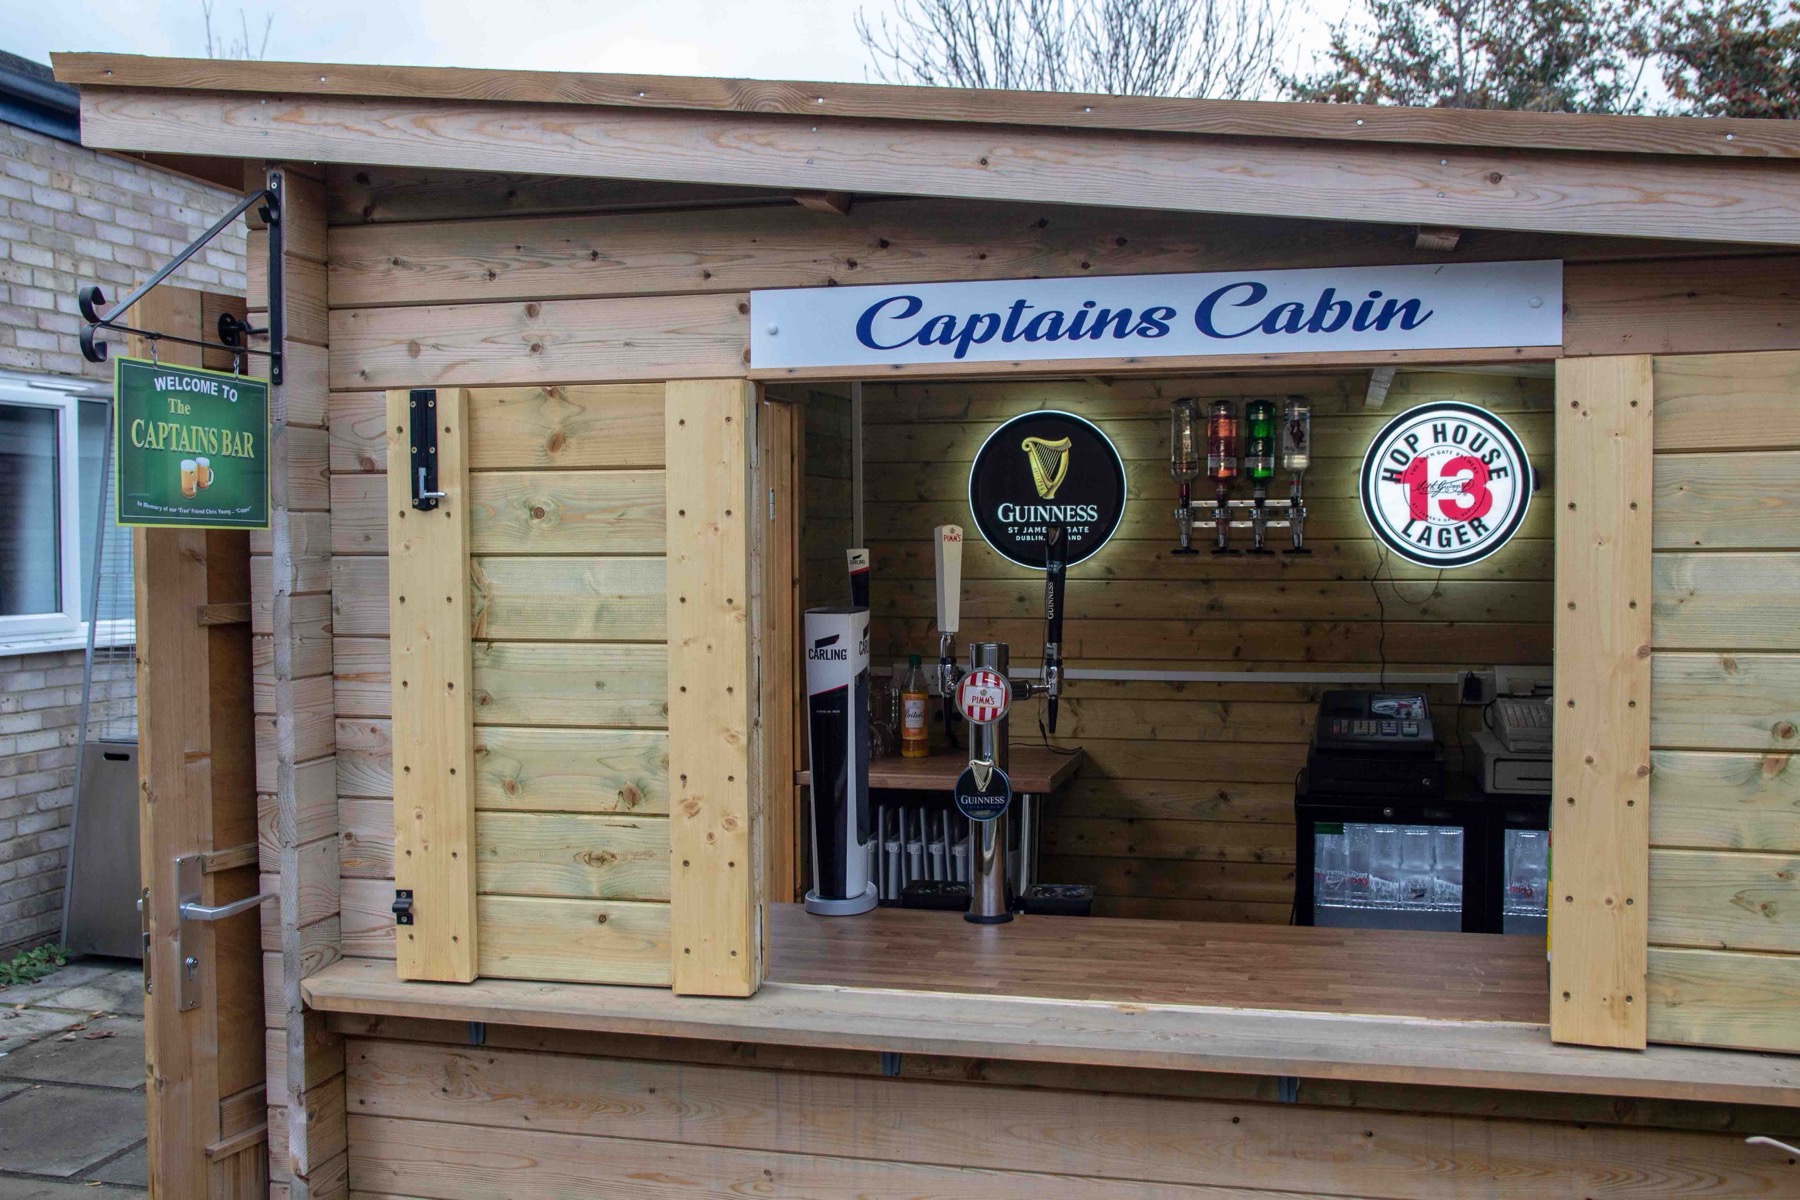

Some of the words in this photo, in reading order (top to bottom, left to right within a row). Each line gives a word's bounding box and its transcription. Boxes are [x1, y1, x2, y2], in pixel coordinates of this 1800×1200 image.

[855, 295, 1171, 359] Captains
[1194, 281, 1434, 339] Cabin
[154, 376, 218, 396] WELCOME
[222, 384, 238, 402] TO
[168, 397, 191, 415] The
[131, 418, 218, 456] CAPTAINS
[221, 429, 255, 459] BAR
[1381, 433, 1419, 484] HOP
[1432, 422, 1509, 482] HOUSE
[1395, 455, 1493, 522] 13
[997, 502, 1098, 523] GUINNESS
[943, 533, 961, 543] PIMM'S
[1007, 526, 1019, 534] ST
[1023, 526, 1048, 534] JAME
[1401, 516, 1490, 548] LAGER
[808, 648, 848, 661] CARLING
[971, 695, 995, 706] PIMM'S
[960, 795, 1005, 806] GUINNESS
